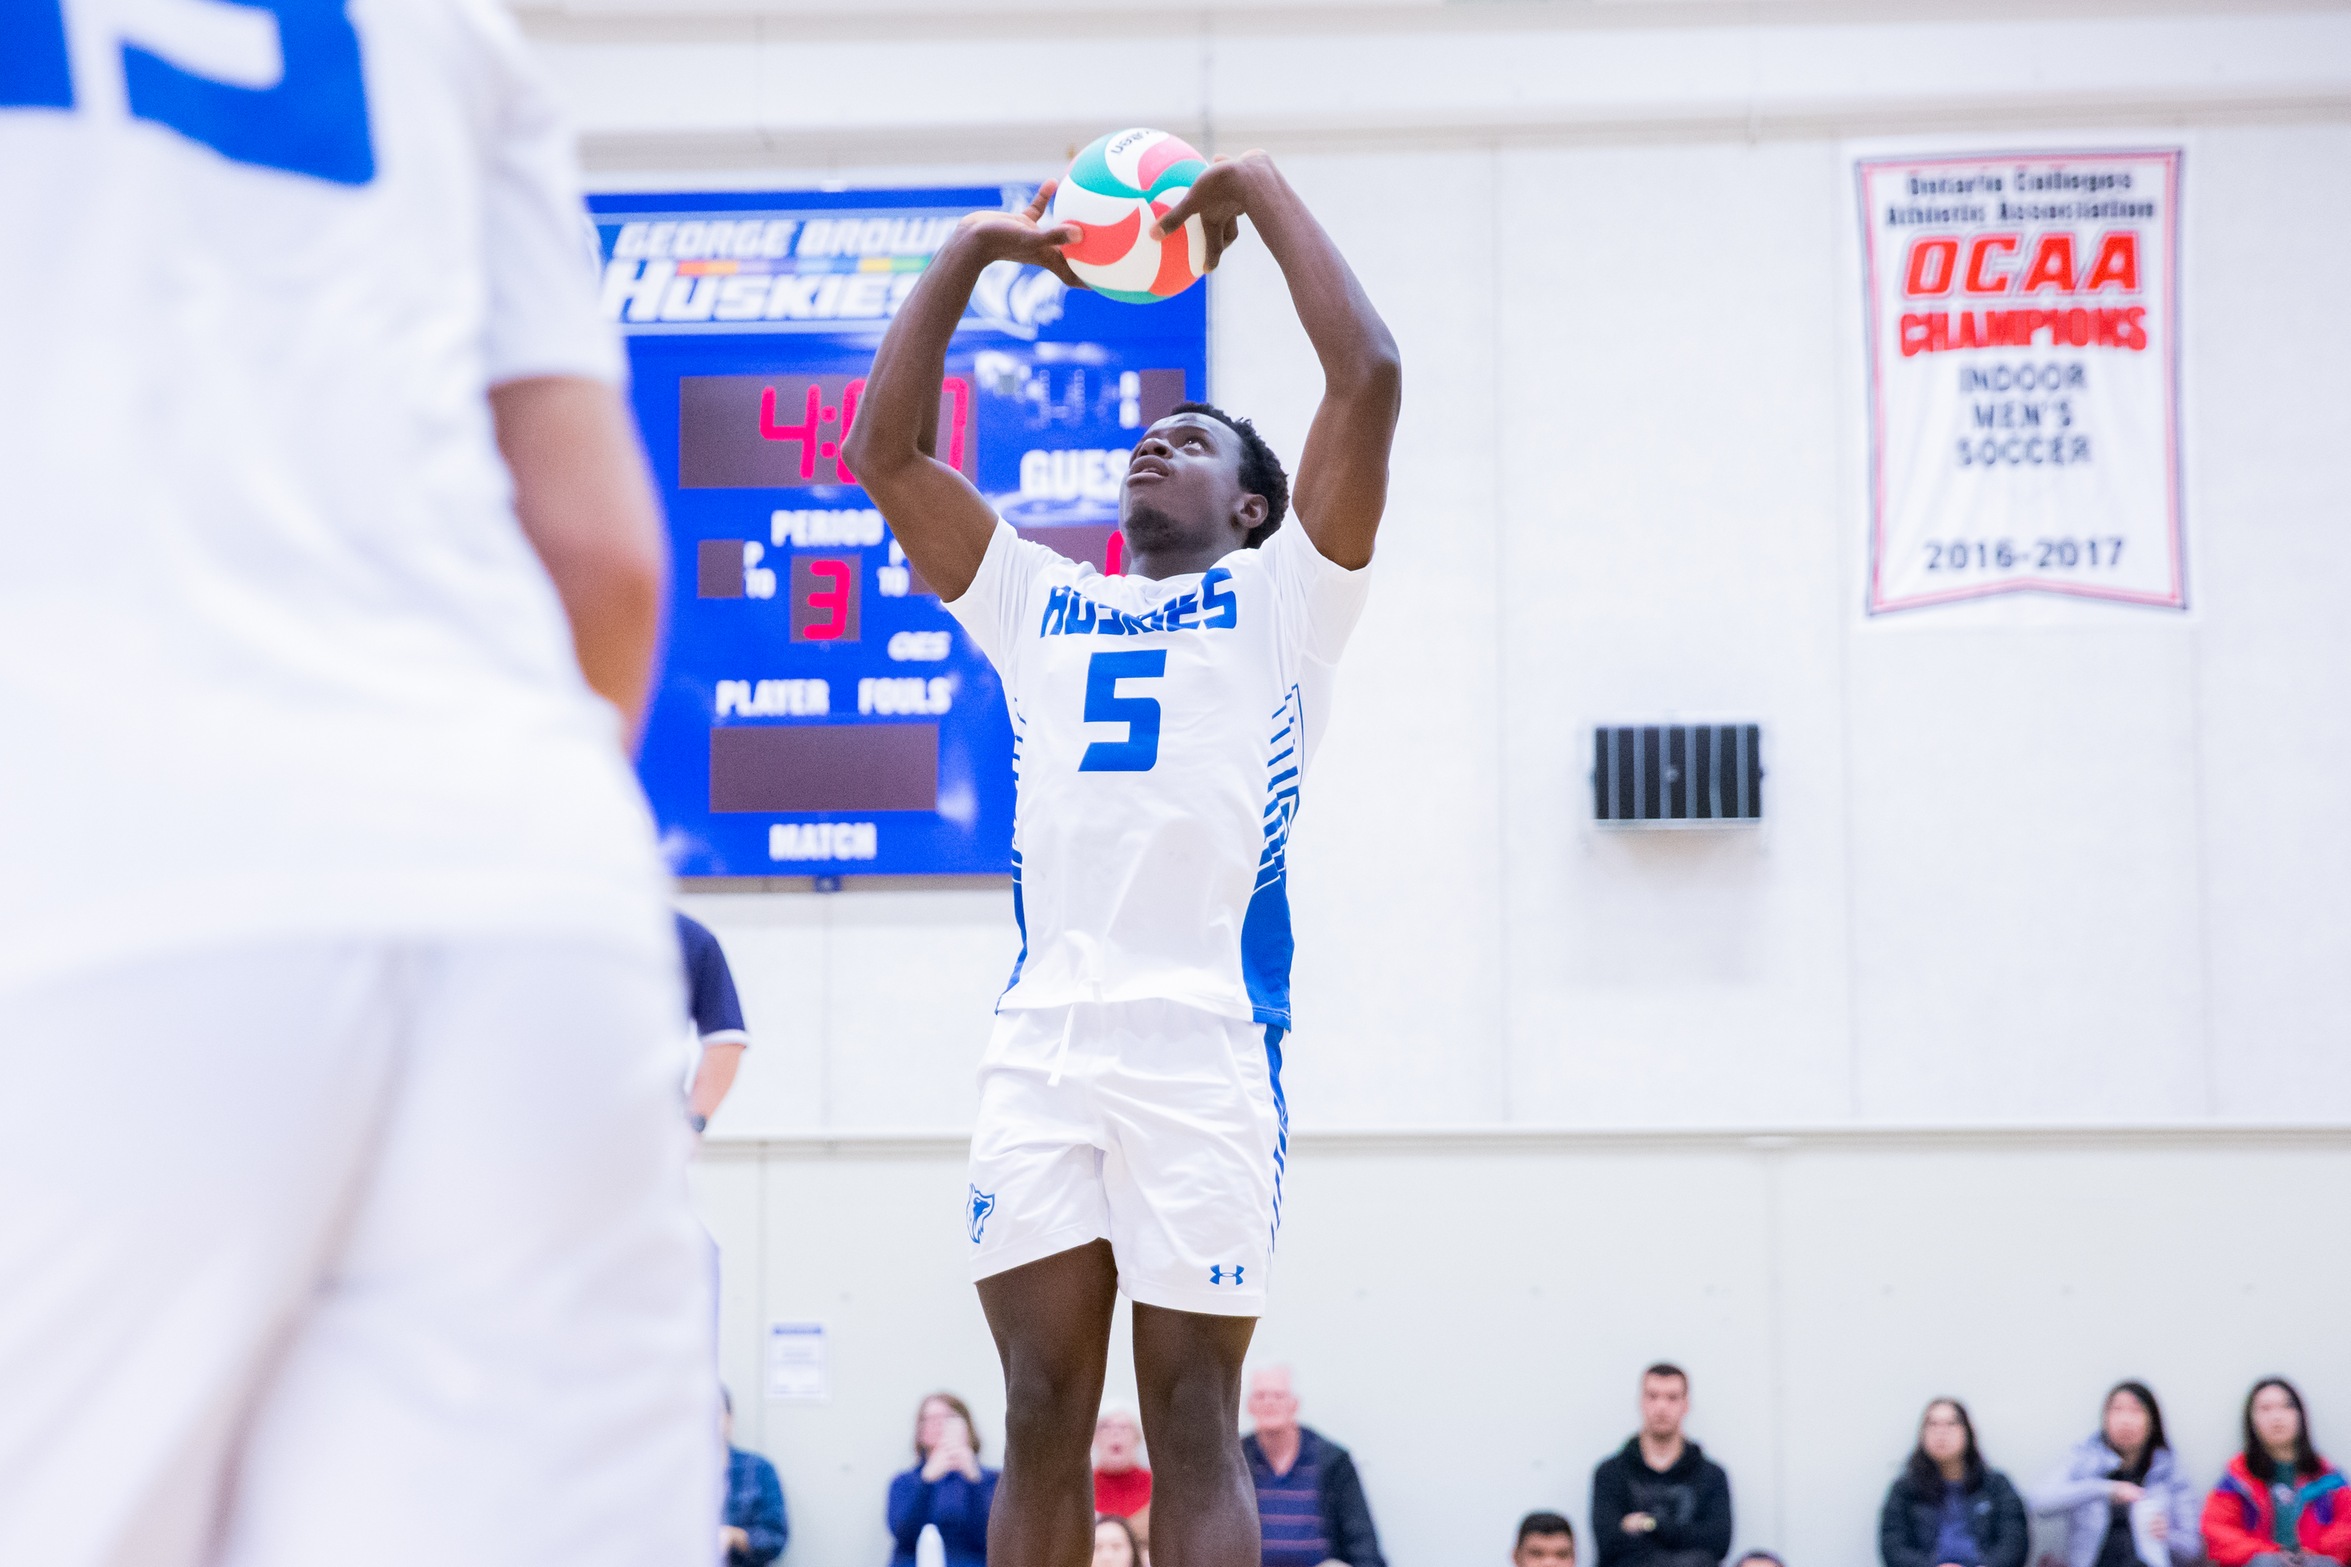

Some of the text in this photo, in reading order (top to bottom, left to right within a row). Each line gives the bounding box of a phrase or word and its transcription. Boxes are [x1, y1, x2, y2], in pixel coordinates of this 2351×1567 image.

[612, 219, 796, 259] GEORGE
[1900, 230, 2143, 299] OCAA
[1900, 306, 2147, 357] CHAMPIONS
[1959, 363, 2088, 394] INDOOR
[1971, 399, 2073, 428] MEN'S
[1956, 433, 2092, 467] SOCCER
[1020, 450, 1136, 501] GUES
[771, 509, 884, 547] PERIOD
[1925, 535, 2126, 570] 2016-2017
[803, 560, 850, 640] 3
[1040, 568, 1237, 638] HUSKIES
[715, 677, 951, 717] PLAYER FOULS
[1078, 649, 1167, 772] 5
[769, 823, 877, 861] MATCH
